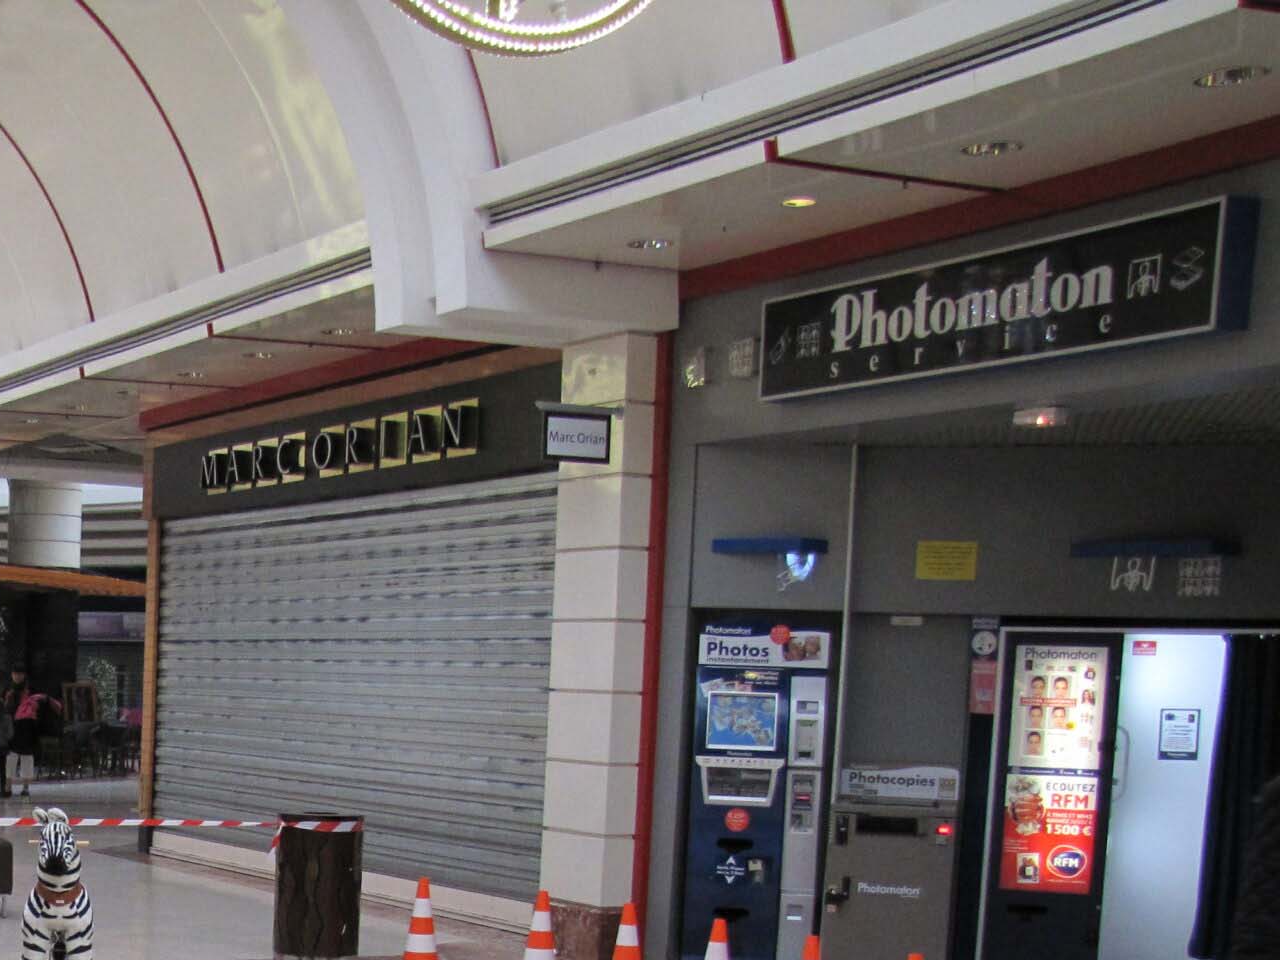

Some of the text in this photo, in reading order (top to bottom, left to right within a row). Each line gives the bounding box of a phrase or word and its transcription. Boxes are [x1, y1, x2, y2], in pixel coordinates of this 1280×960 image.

[830, 257, 1113, 352] Photomaton
[829, 314, 1113, 379] service
[549, 431, 605, 445] Marc Orian
[707, 640, 769, 658] Photos
[1024, 647, 1097, 660] Photomaton
[848, 771, 935, 787] Photocopies
[1046, 781, 1096, 793] ECOUTEZ
[1050, 793, 1090, 809] RFM
[1046, 824, 1092, 837] 1500 €
[1054, 857, 1079, 868] RFM
[857, 882, 920, 896] Photomaton
